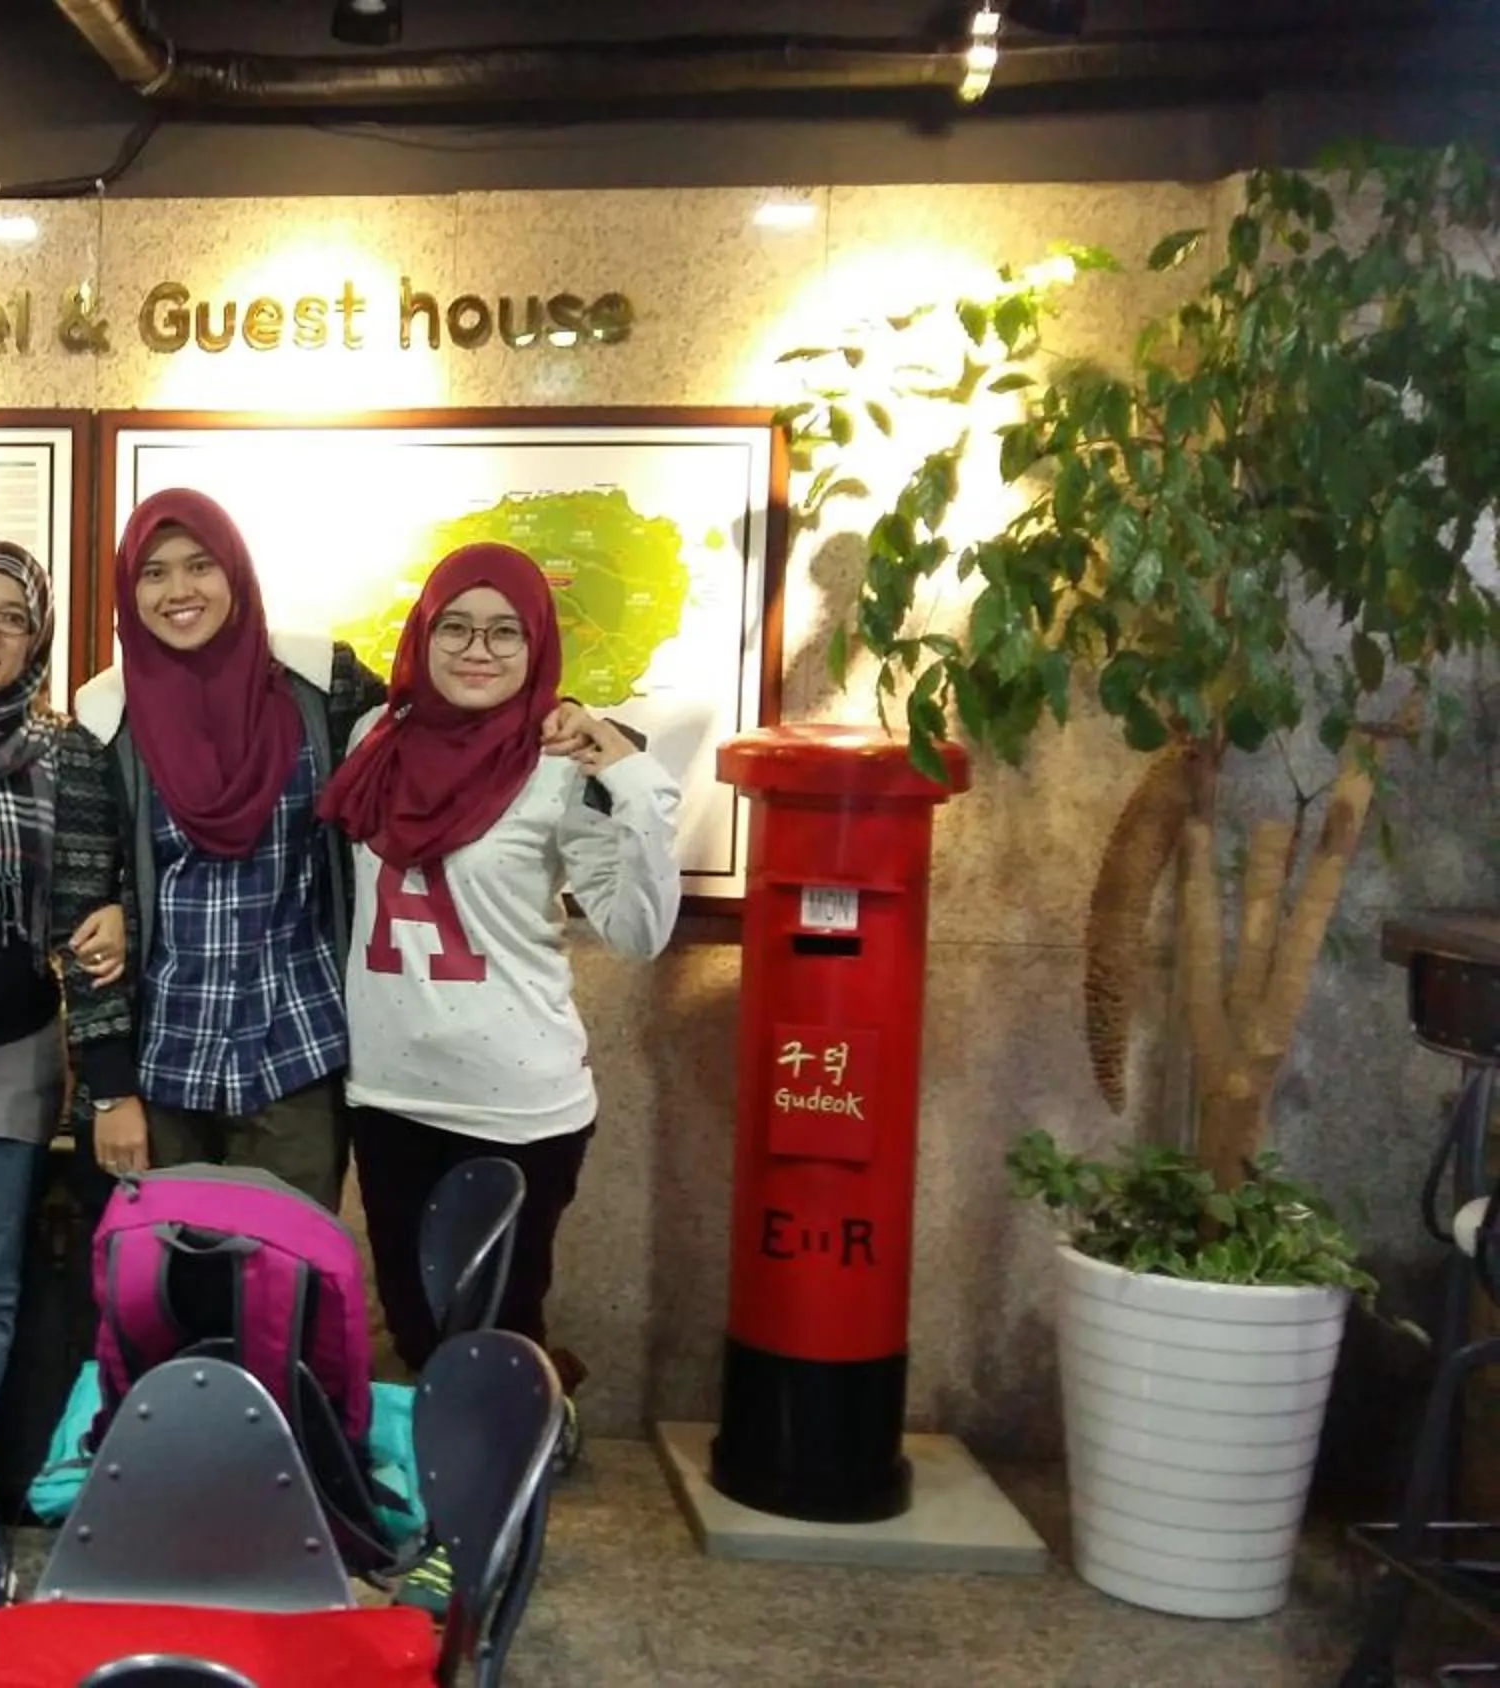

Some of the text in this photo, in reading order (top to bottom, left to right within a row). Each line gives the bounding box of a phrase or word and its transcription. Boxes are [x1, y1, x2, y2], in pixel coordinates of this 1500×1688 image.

[58, 282, 111, 356] &
[139, 280, 367, 353] Guest
[399, 276, 635, 350] house
